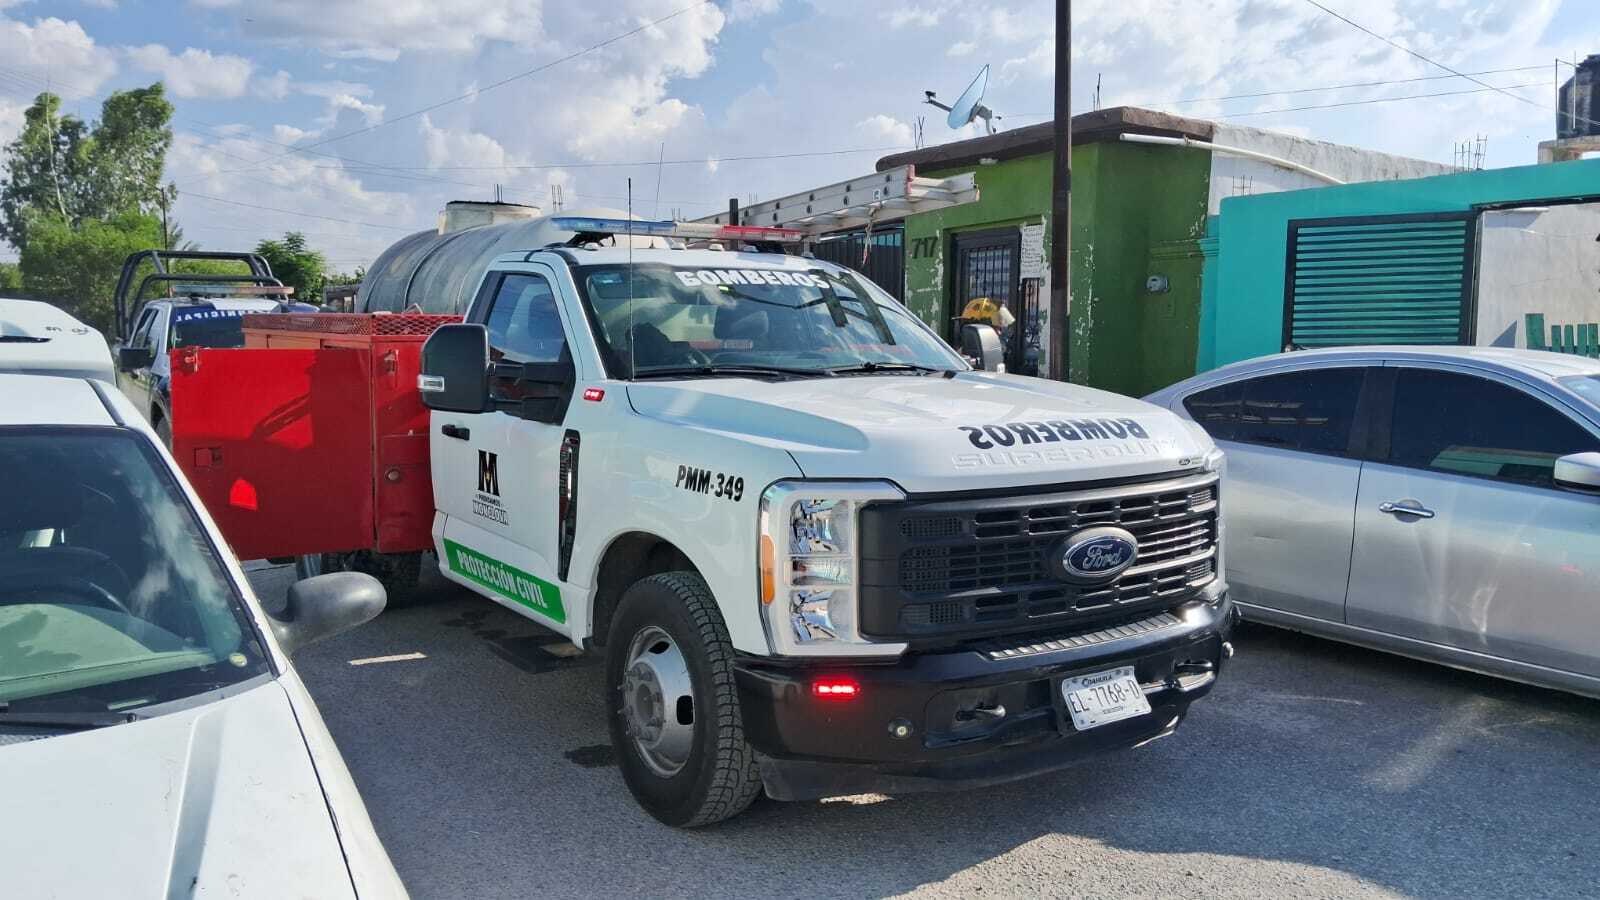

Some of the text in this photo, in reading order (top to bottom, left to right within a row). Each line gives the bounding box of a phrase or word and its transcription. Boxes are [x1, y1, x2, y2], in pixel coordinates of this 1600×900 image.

[911, 236, 938, 259] 717
[674, 270, 831, 289] BOMBEROS
[675, 464, 745, 502] PMM-349
[1082, 543, 1123, 570] Ford
[455, 548, 548, 609] PROTECCIÓN CIVIL
